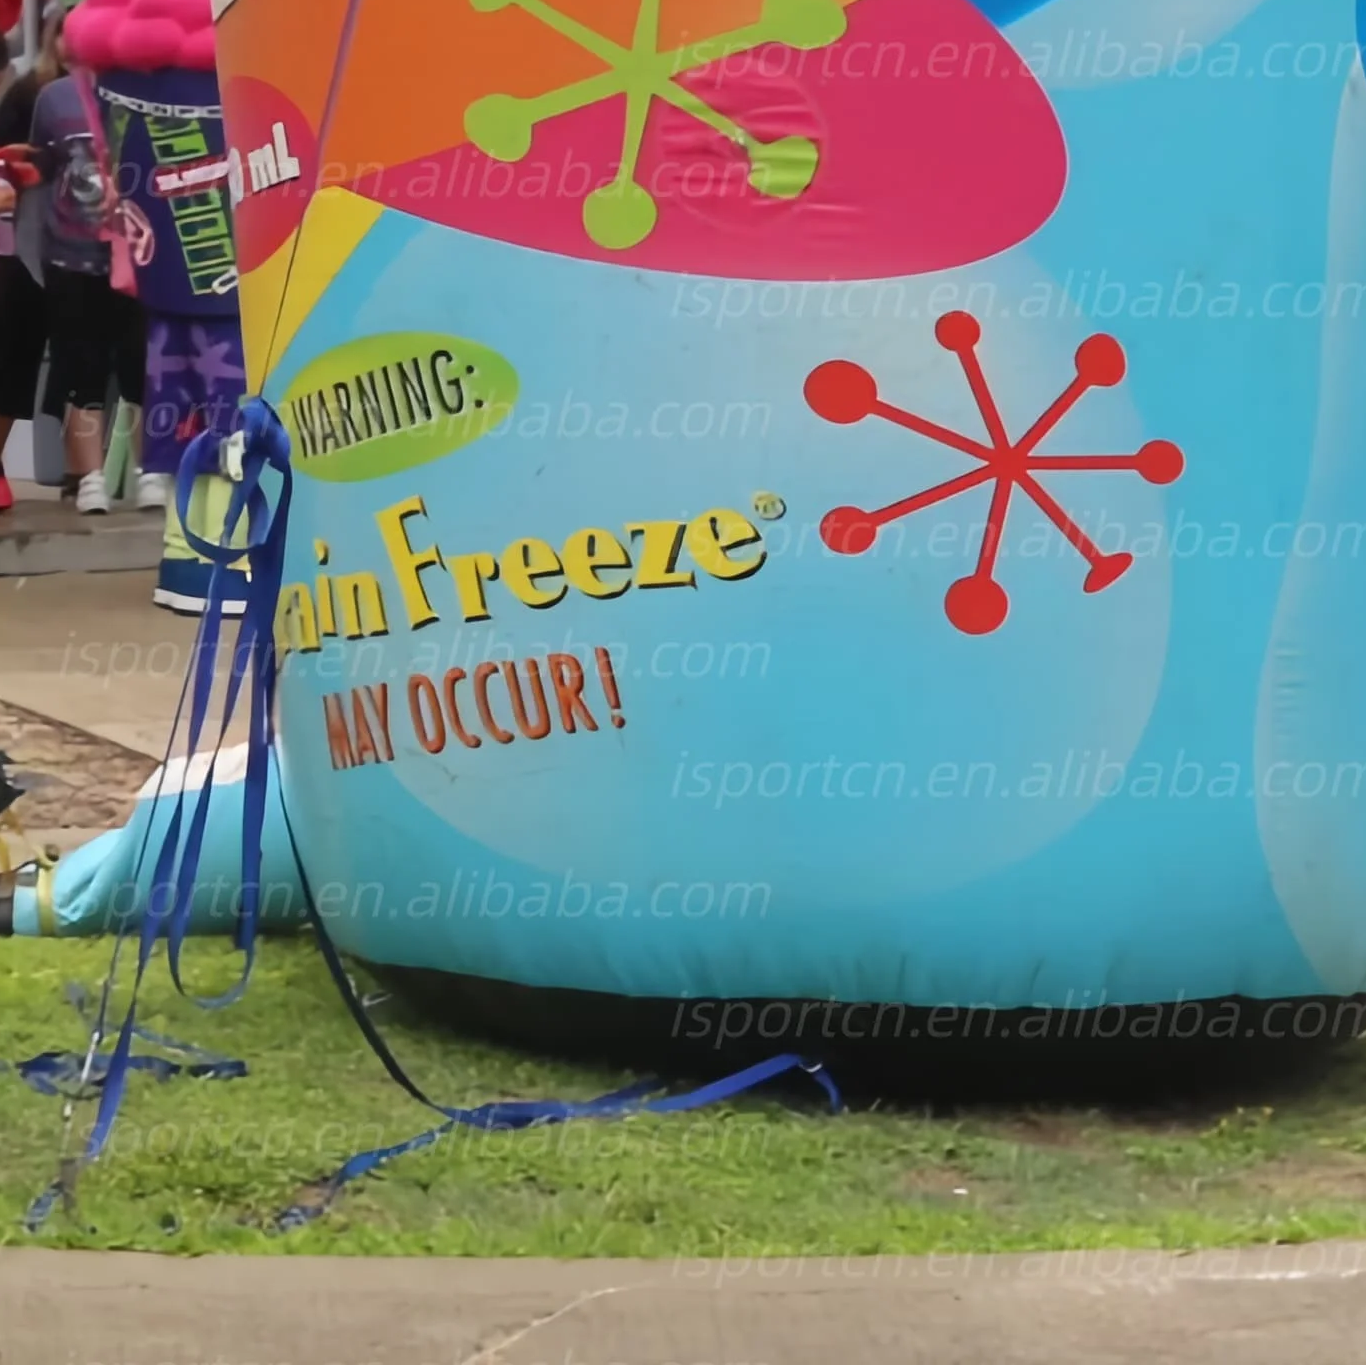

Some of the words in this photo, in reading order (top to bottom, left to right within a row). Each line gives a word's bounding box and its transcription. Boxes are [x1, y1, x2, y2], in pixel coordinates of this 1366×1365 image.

[290, 349, 486, 459] WARNING:
[322, 682, 395, 771] MAY
[407, 645, 627, 756] OCCUR!
